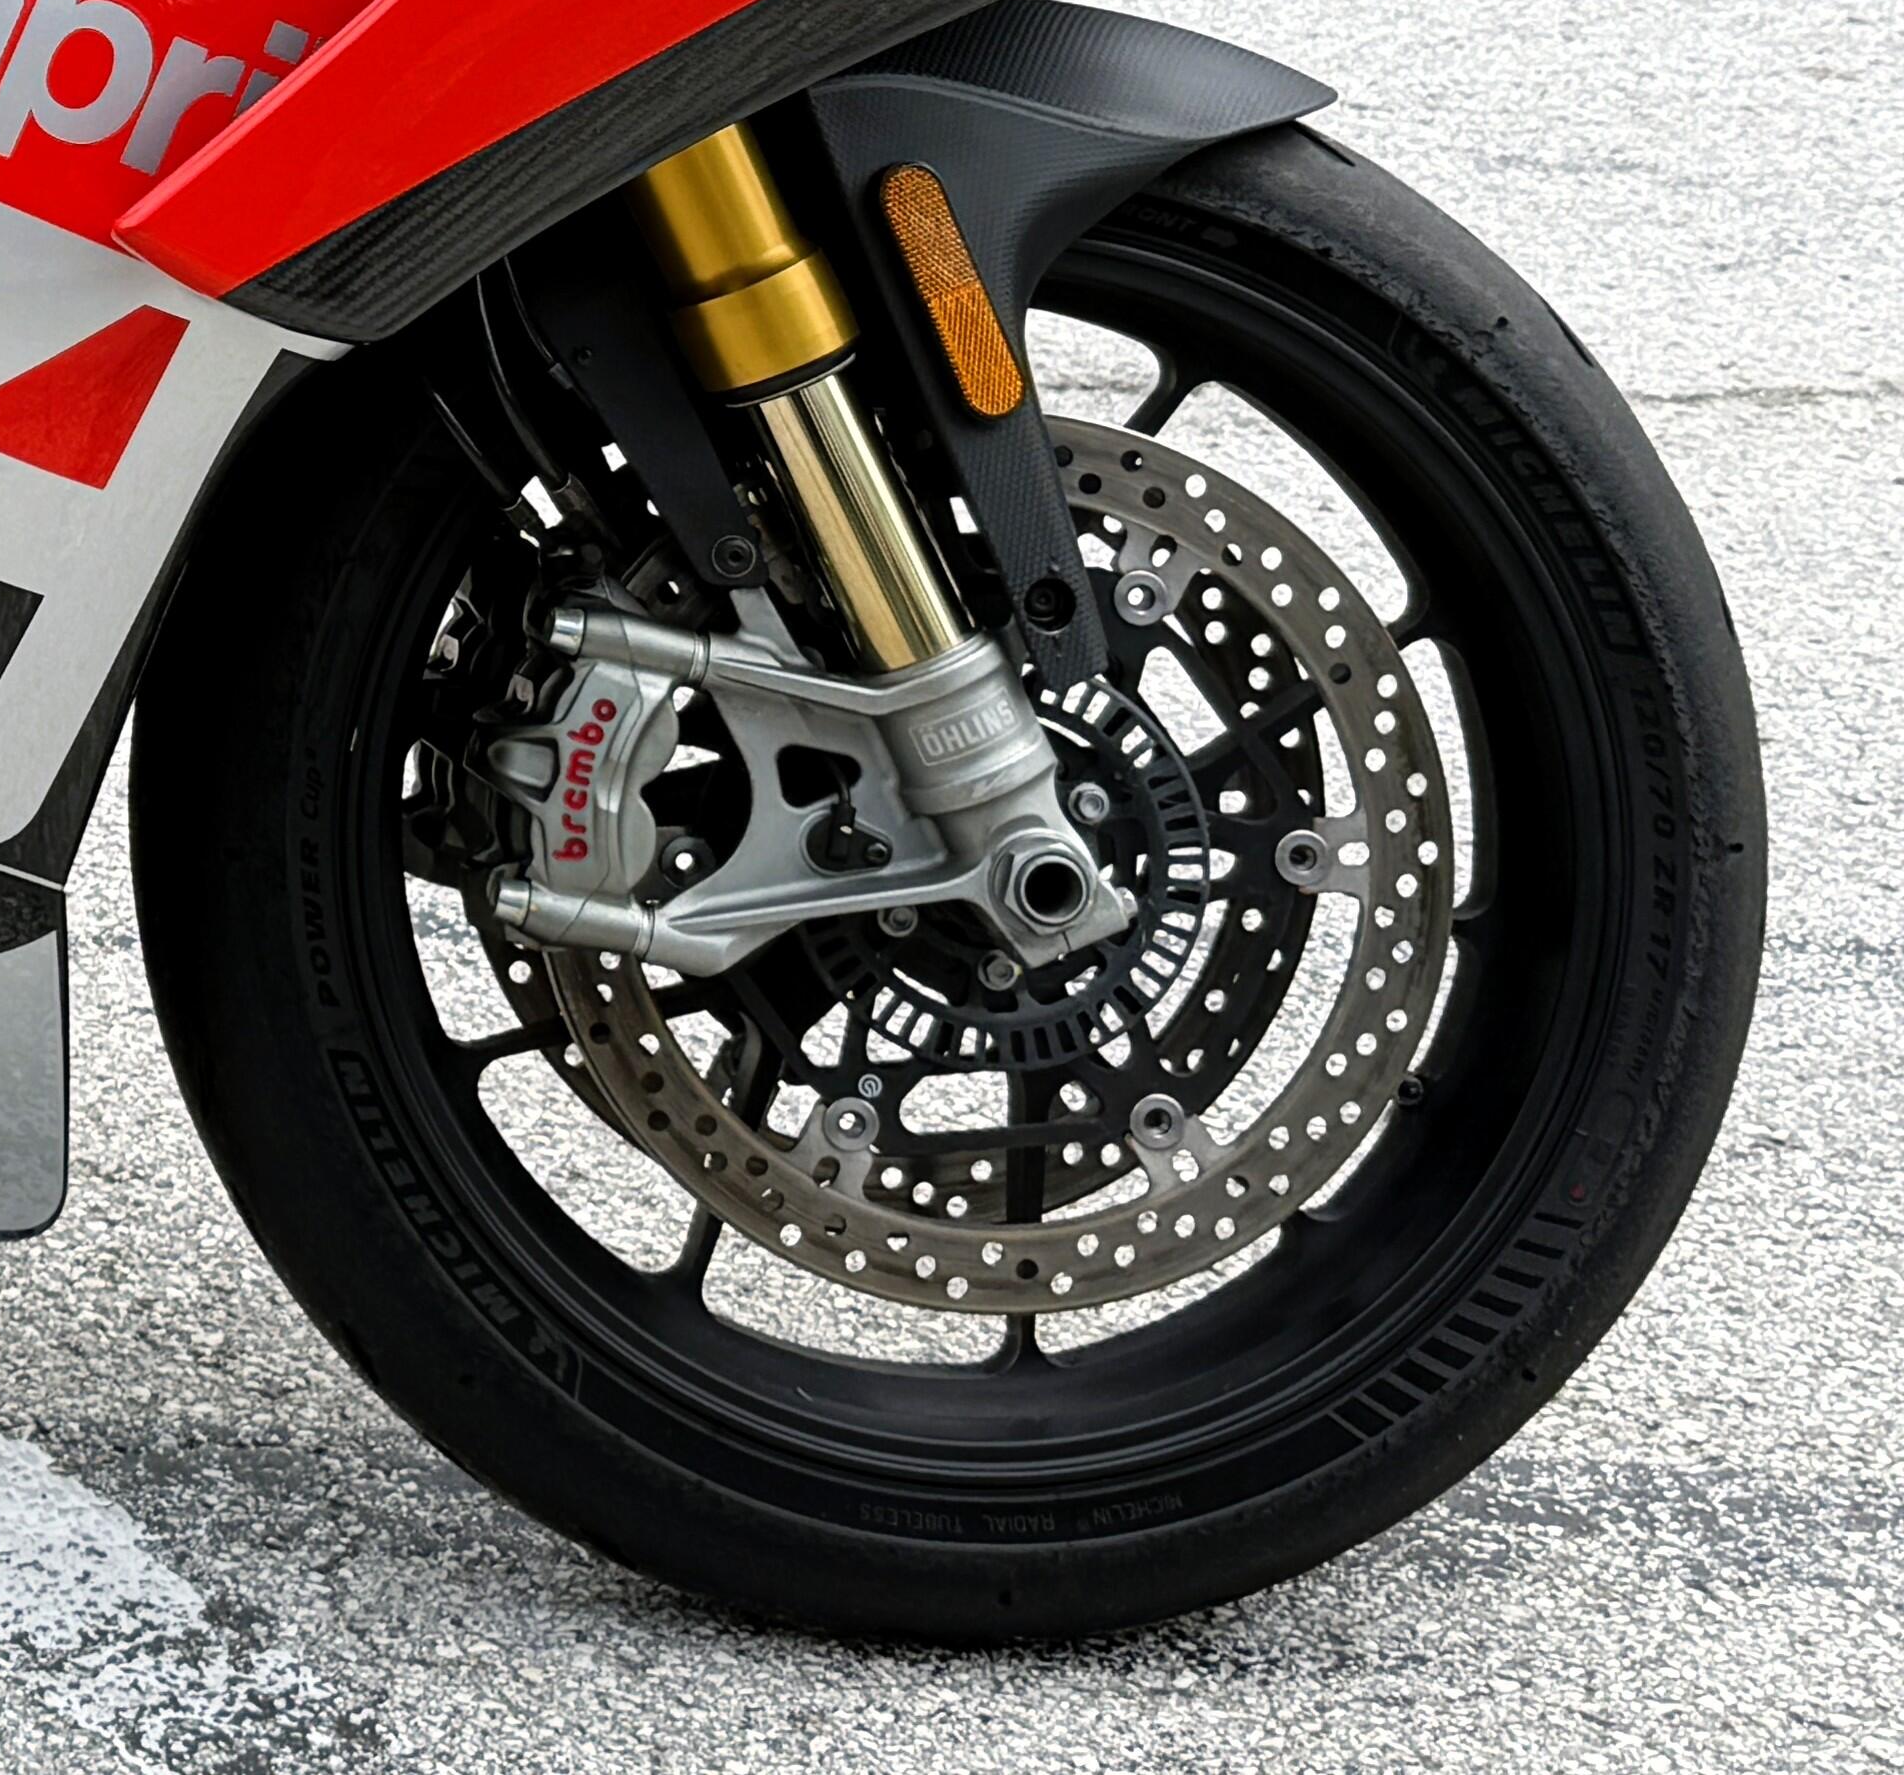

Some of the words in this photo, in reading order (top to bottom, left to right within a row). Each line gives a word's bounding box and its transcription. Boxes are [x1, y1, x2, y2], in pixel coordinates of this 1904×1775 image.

[1451, 384, 1641, 649] MICHELIN
[552, 698, 617, 862] brembo
[917, 698, 1016, 757] ÖHLINS
[1629, 686, 1676, 841] 120/70
[299, 837, 341, 1009] POWER
[337, 1059, 522, 1325] MICHELIN
[859, 1502, 964, 1535] TUBELESS
[980, 1511, 1057, 1534] RADIAL
